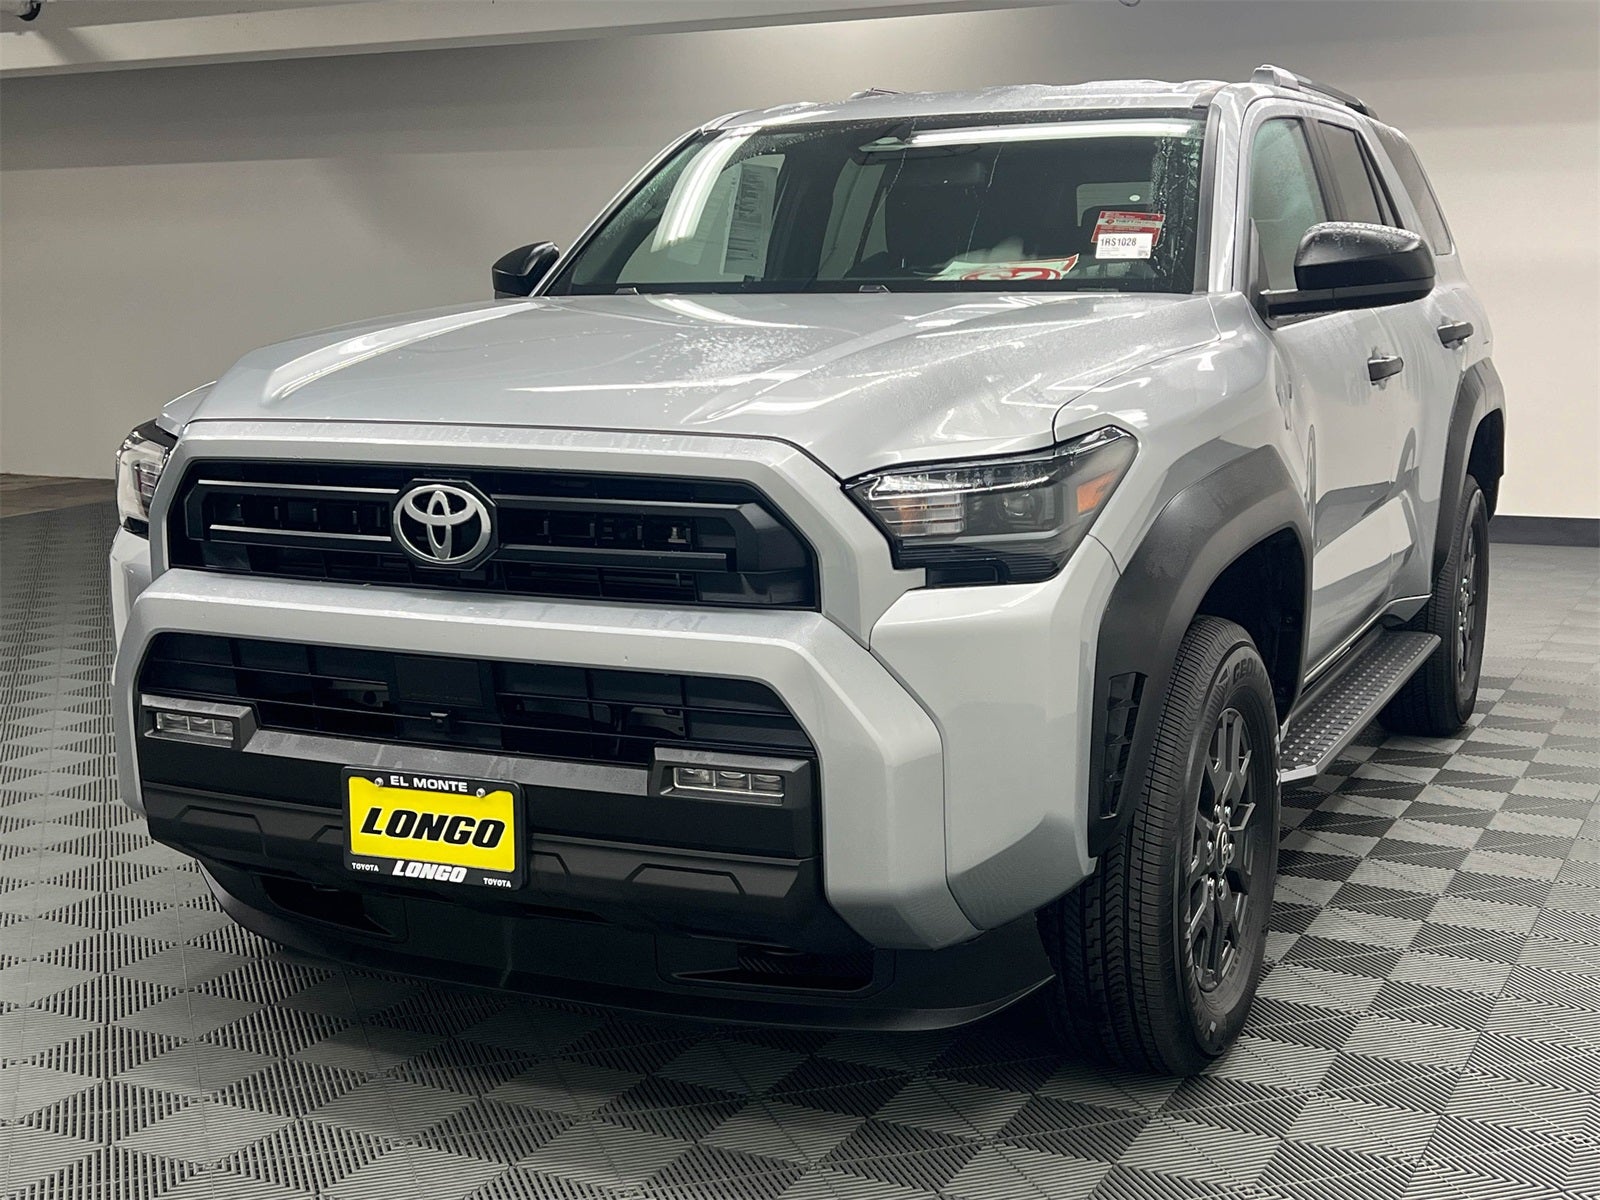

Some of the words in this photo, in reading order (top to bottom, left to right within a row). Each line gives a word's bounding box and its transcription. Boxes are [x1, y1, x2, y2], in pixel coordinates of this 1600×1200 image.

[390, 775, 409, 787] EL
[413, 777, 468, 792] MONTE
[360, 807, 506, 849] LONGO
[351, 862, 379, 872] TOYOTA
[392, 860, 468, 883] LONGO
[483, 877, 512, 888] TOYOTA
